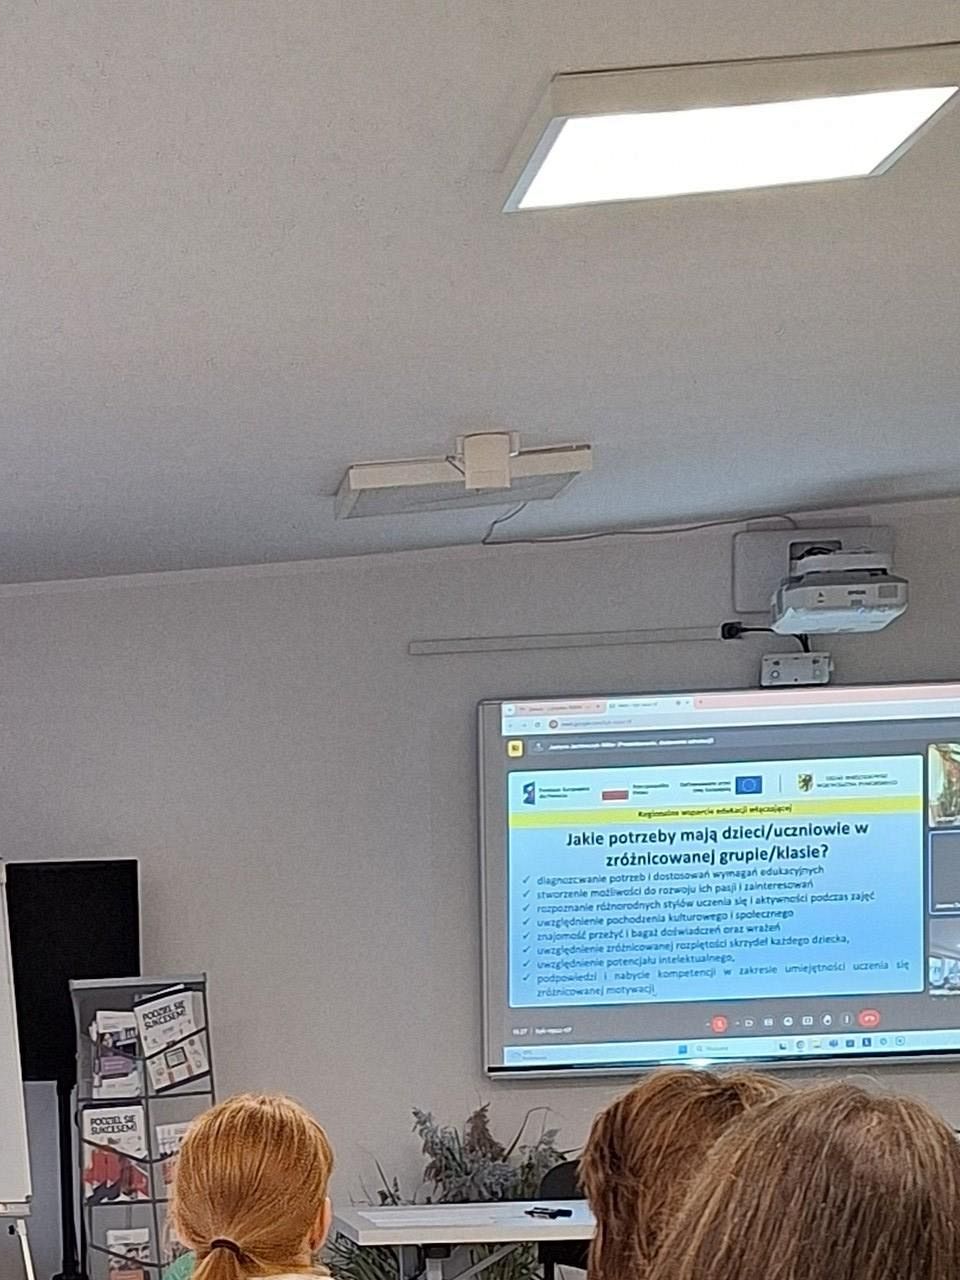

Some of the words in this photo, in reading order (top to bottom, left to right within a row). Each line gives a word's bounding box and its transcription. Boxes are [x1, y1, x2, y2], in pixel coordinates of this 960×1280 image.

[566, 832, 604, 847] Jakie
[609, 829, 676, 847] potrzeby
[680, 827, 717, 844] mają
[722, 821, 850, 840] dzieci/uczniowie
[854, 823, 869, 834] w
[606, 849, 715, 867] zróżnicowanej
[720, 844, 829, 865] grupie/klasie?
[537, 874, 607, 887] diagnozowanie
[609, 873, 646, 885] potrzeb
[653, 870, 711, 881] dostosowań
[713, 867, 758, 879] wymagań
[760, 865, 824, 877] edukacyjnych
[537, 888, 588, 900] stworzenie
[591, 886, 641, 898] możliwości
[644, 886, 656, 895] do
[659, 885, 696, 897] rozwoju
[699, 883, 712, 893] ich
[715, 882, 737, 894] pasji
[744, 879, 813, 891] zainteresowań
[537, 902, 593, 914] rozpoznanie
[596, 900, 661, 912] różnorodnych
[663, 899, 693, 910] stylów
[697, 897, 732, 907] uczenia
[734, 896, 747, 907] się
[755, 893, 808, 905] aktywności
[810, 892, 848, 904] podczas
[537, 915, 604, 928] uwzględnienie
[607, 913, 665, 926] pochodzenia
[668, 911, 728, 924] kulturowego
[537, 930, 586, 942] znajomość
[589, 929, 624, 940] przeżyć
[661, 925, 721, 937] doświadczeń
[723, 925, 744, 934] oraz
[537, 944, 604, 956] uwzględnienie
[607, 942, 674, 953] zróżnicowanej
[676, 939, 727, 951] rozpiętości
[730, 936, 768, 948] skrzydeł
[770, 935, 809, 946] każdego
[812, 933, 850, 944] dziecka,
[537, 958, 604, 970] uwzględnienie
[607, 956, 656, 967] potencjału
[537, 973, 597, 985] podpowiedzi
[614, 970, 650, 981] nabycie
[658, 968, 716, 979] kompetencji
[739, 965, 778, 975] zakresie
[785, 962, 845, 974] umiejętności
[853, 961, 889, 971] uczenia
[537, 985, 604, 997] zróżnicowanej
